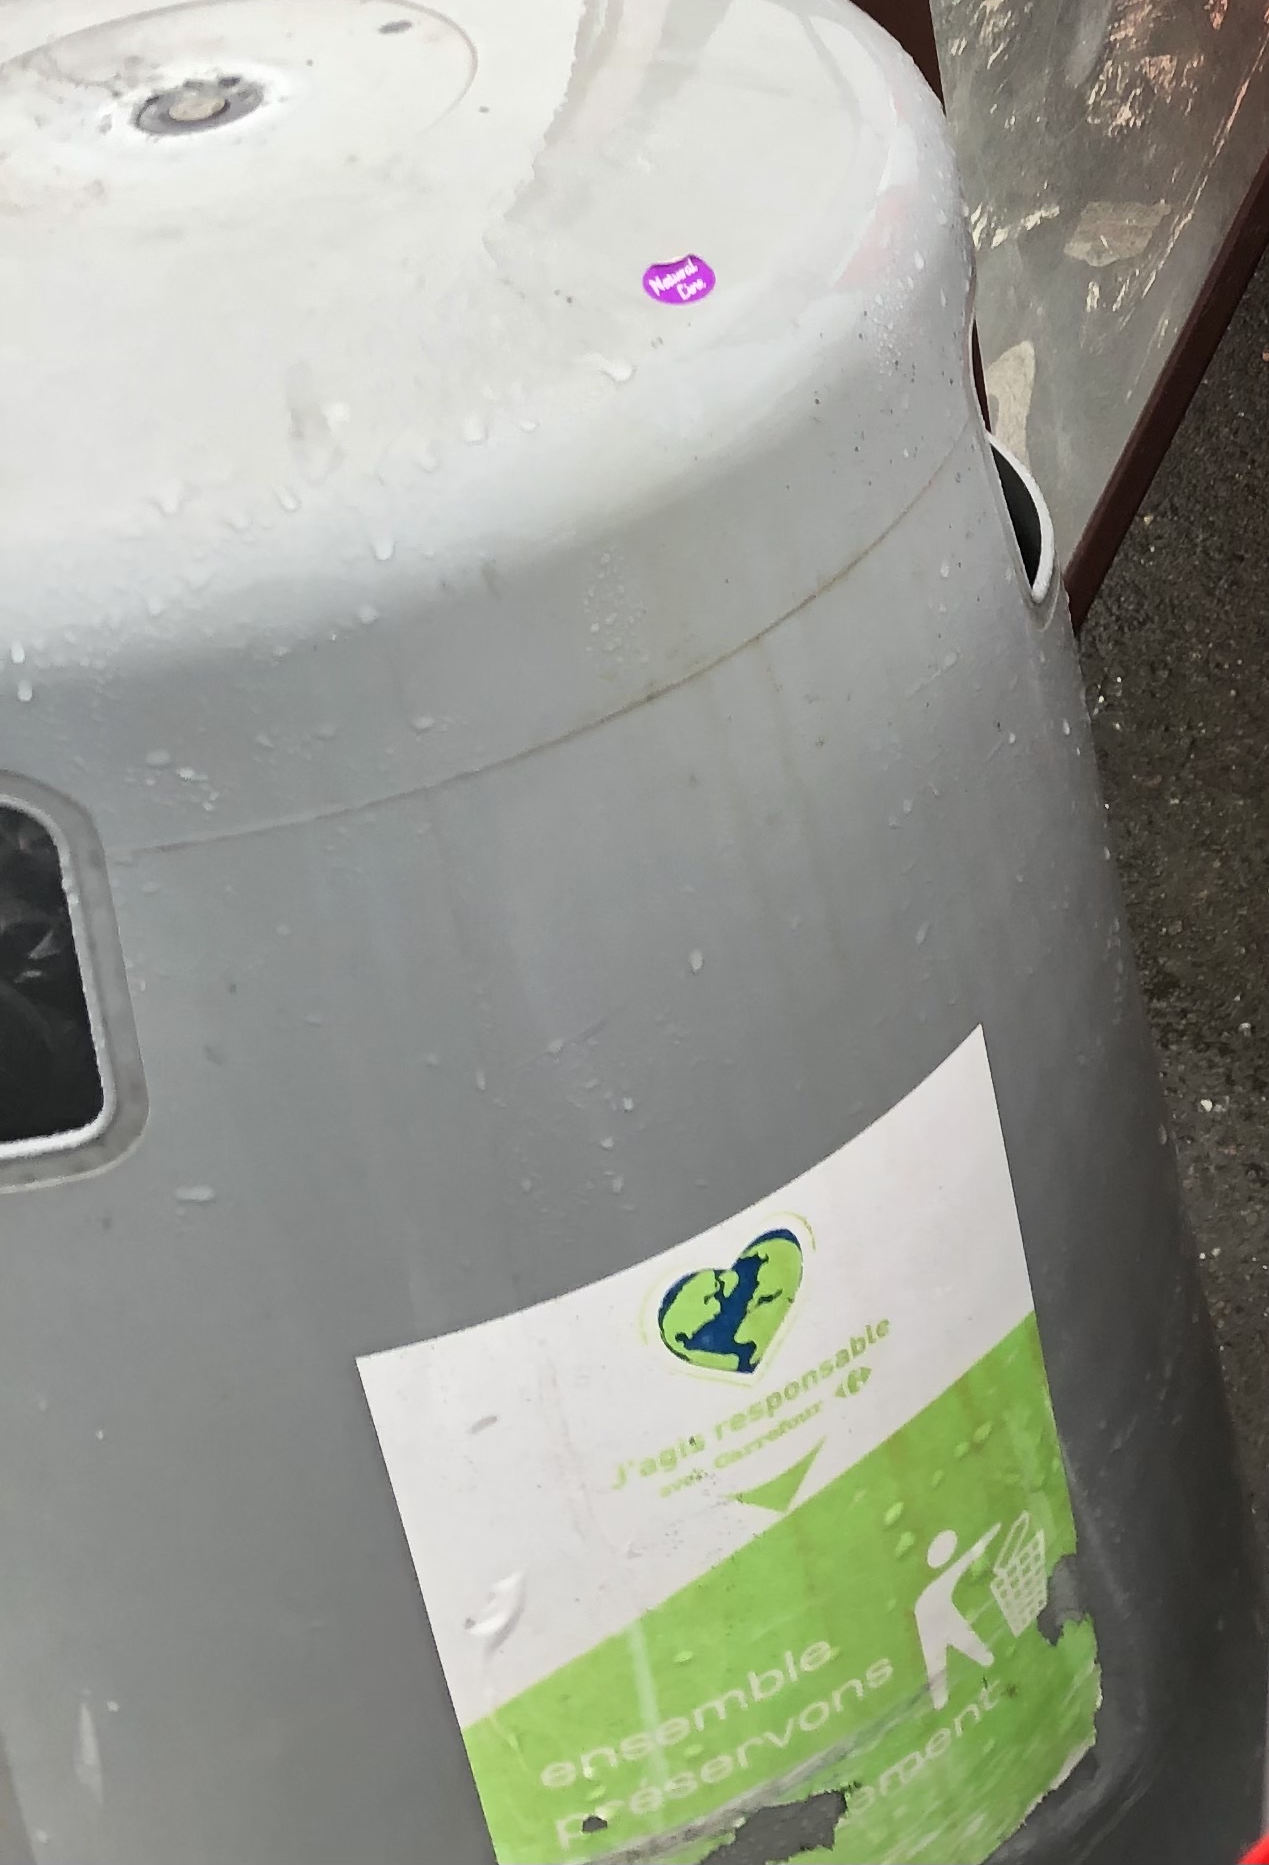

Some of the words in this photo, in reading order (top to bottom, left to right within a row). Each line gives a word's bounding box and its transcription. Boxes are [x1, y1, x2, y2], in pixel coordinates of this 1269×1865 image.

[714, 1318, 890, 1441] responsable
[540, 1640, 835, 1789] ensemble
[555, 1657, 895, 1851] préservons
